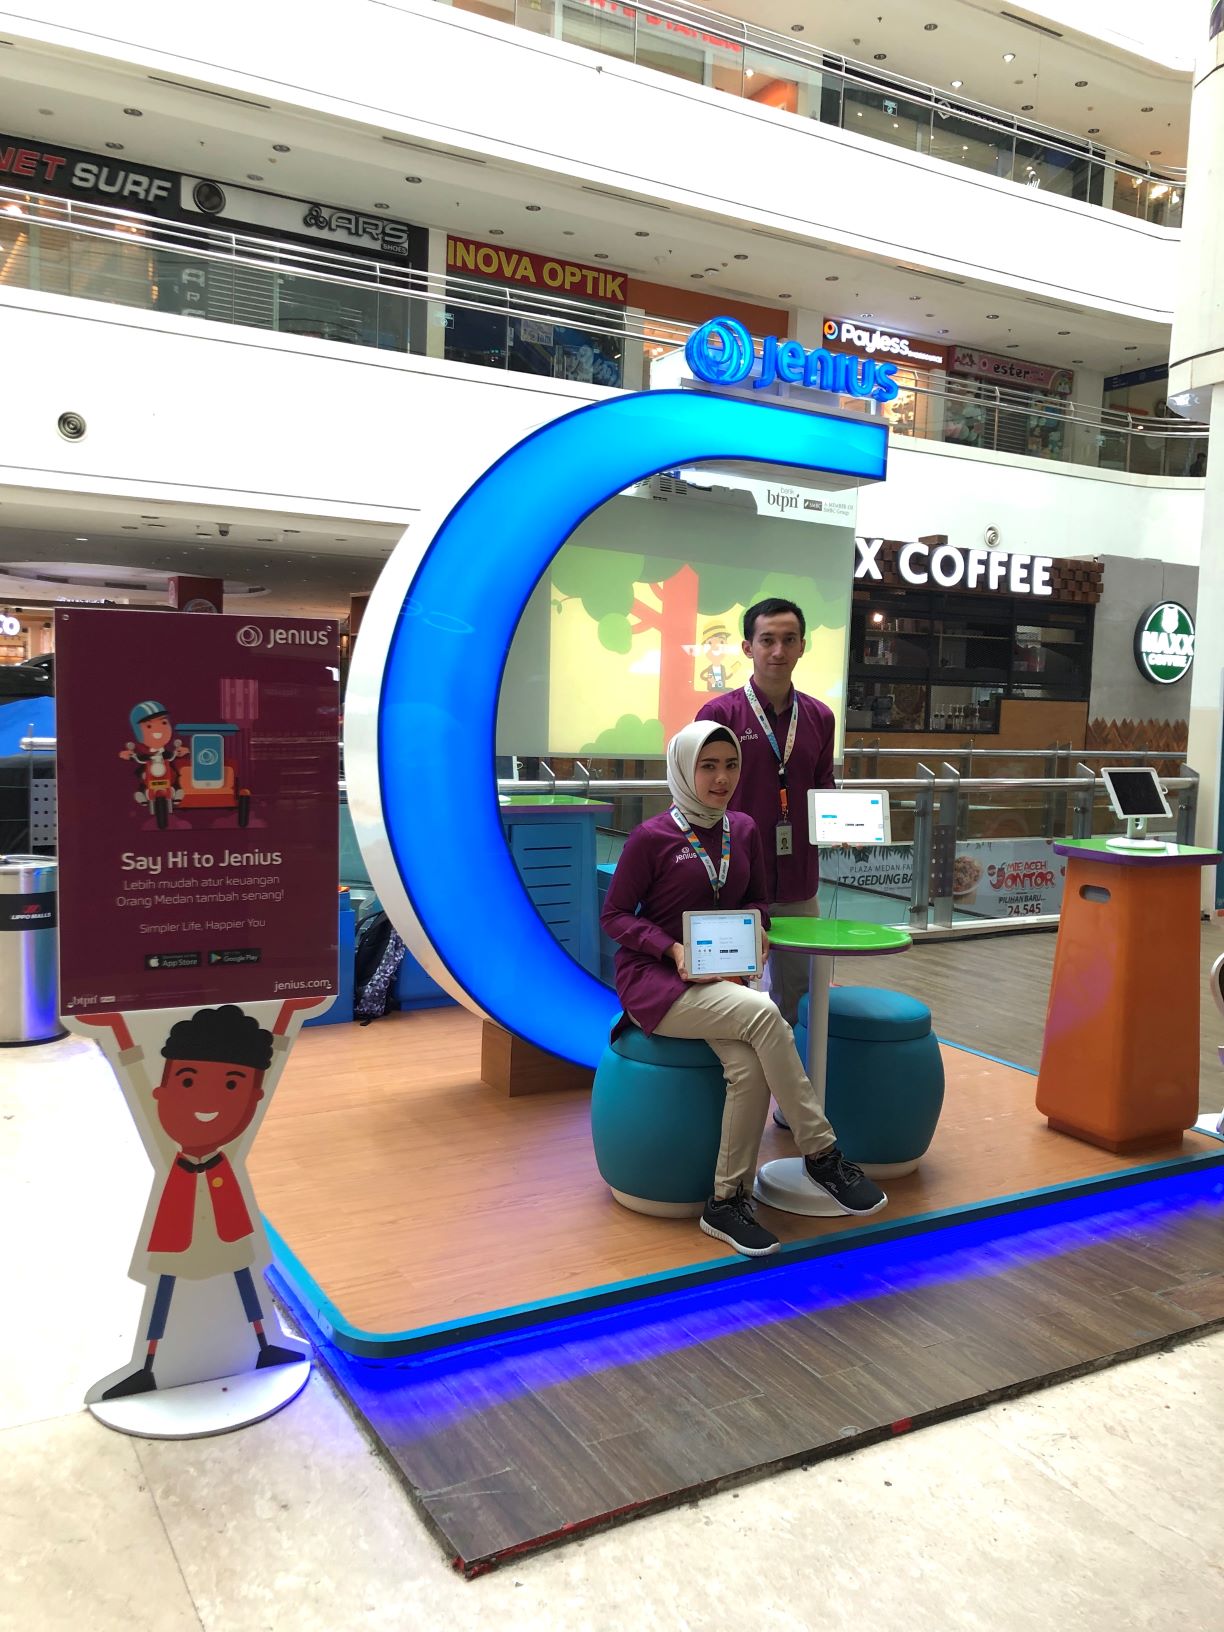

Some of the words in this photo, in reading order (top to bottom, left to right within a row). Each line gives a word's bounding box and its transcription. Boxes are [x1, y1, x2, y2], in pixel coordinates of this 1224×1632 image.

[72, 162, 173, 202] SURF
[330, 212, 409, 244] ARS
[382, 243, 408, 254] SHOES
[448, 239, 537, 283] INOVA
[542, 262, 626, 300] OPTIK
[841, 322, 909, 355] Payless
[900, 542, 1053, 595] COFFEE
[1141, 631, 1195, 656] MAXX
[121, 852, 162, 874] Say
[167, 851, 188, 869] Hi
[192, 851, 214, 868] to
[219, 849, 282, 867] Jenius
[849, 865, 873, 873] PLAZA
[874, 864, 900, 872] MEDAN
[124, 879, 156, 891] Lebih
[158, 877, 198, 889] mudah
[201, 876, 224, 888] atur
[226, 875, 280, 889] keuangan
[857, 874, 900, 886] GEDUNG
[989, 866, 1055, 890] JONTOR
[116, 895, 152, 908] Orang
[154, 893, 194, 906] Medan
[196, 891, 240, 904] tambah
[241, 889, 285, 902] senang!
[999, 895, 1024, 904] PILIHAN
[1008, 903, 1042, 916] 24.545
[139, 922, 180, 935] Simpler
[206, 919, 245, 931] Happier
[247, 918, 266, 928] You
[163, 960, 178, 968] App
[179, 958, 198, 966] Store
[273, 979, 330, 992] jenius.com
